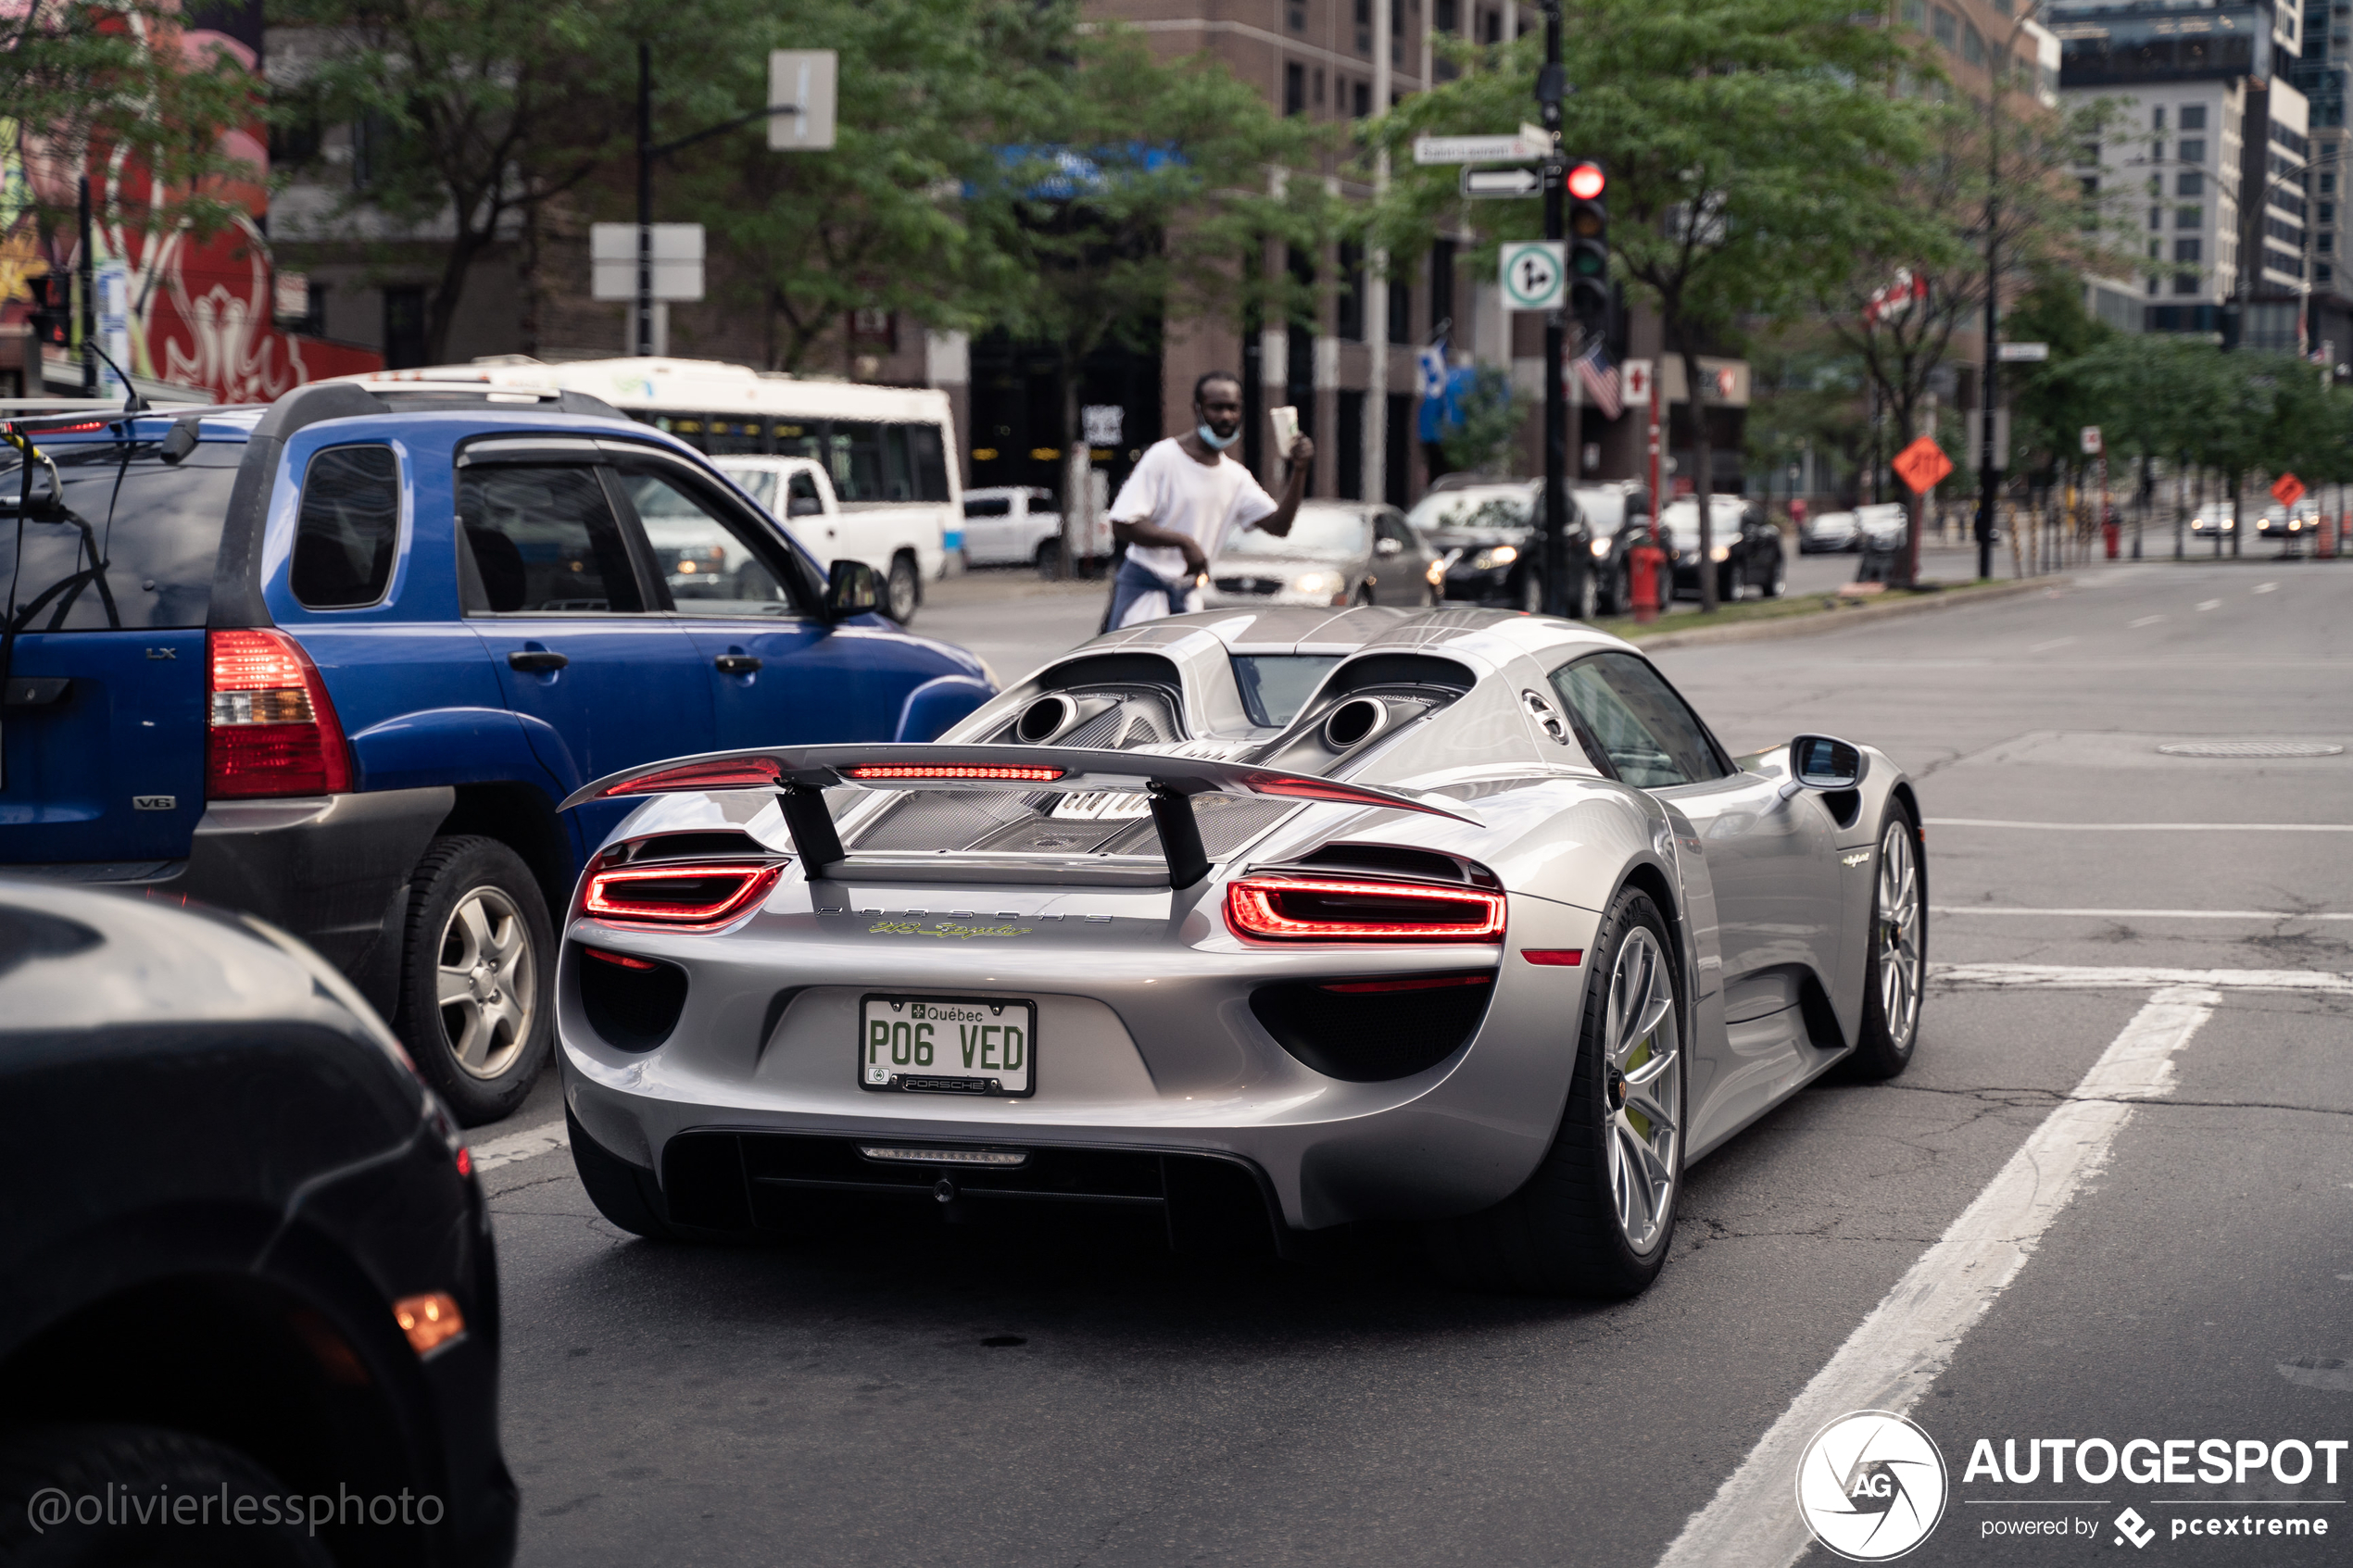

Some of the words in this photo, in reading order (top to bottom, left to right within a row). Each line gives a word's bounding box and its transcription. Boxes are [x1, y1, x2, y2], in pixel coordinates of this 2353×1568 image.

[145, 647, 176, 659] LX
[136, 797, 170, 809] V6
[816, 906, 1114, 924] PORSCHE
[927, 1007, 983, 1022] Québec
[869, 1020, 934, 1066] P06
[960, 1024, 1024, 1070] VED
[905, 1079, 985, 1090] PORSCHE
